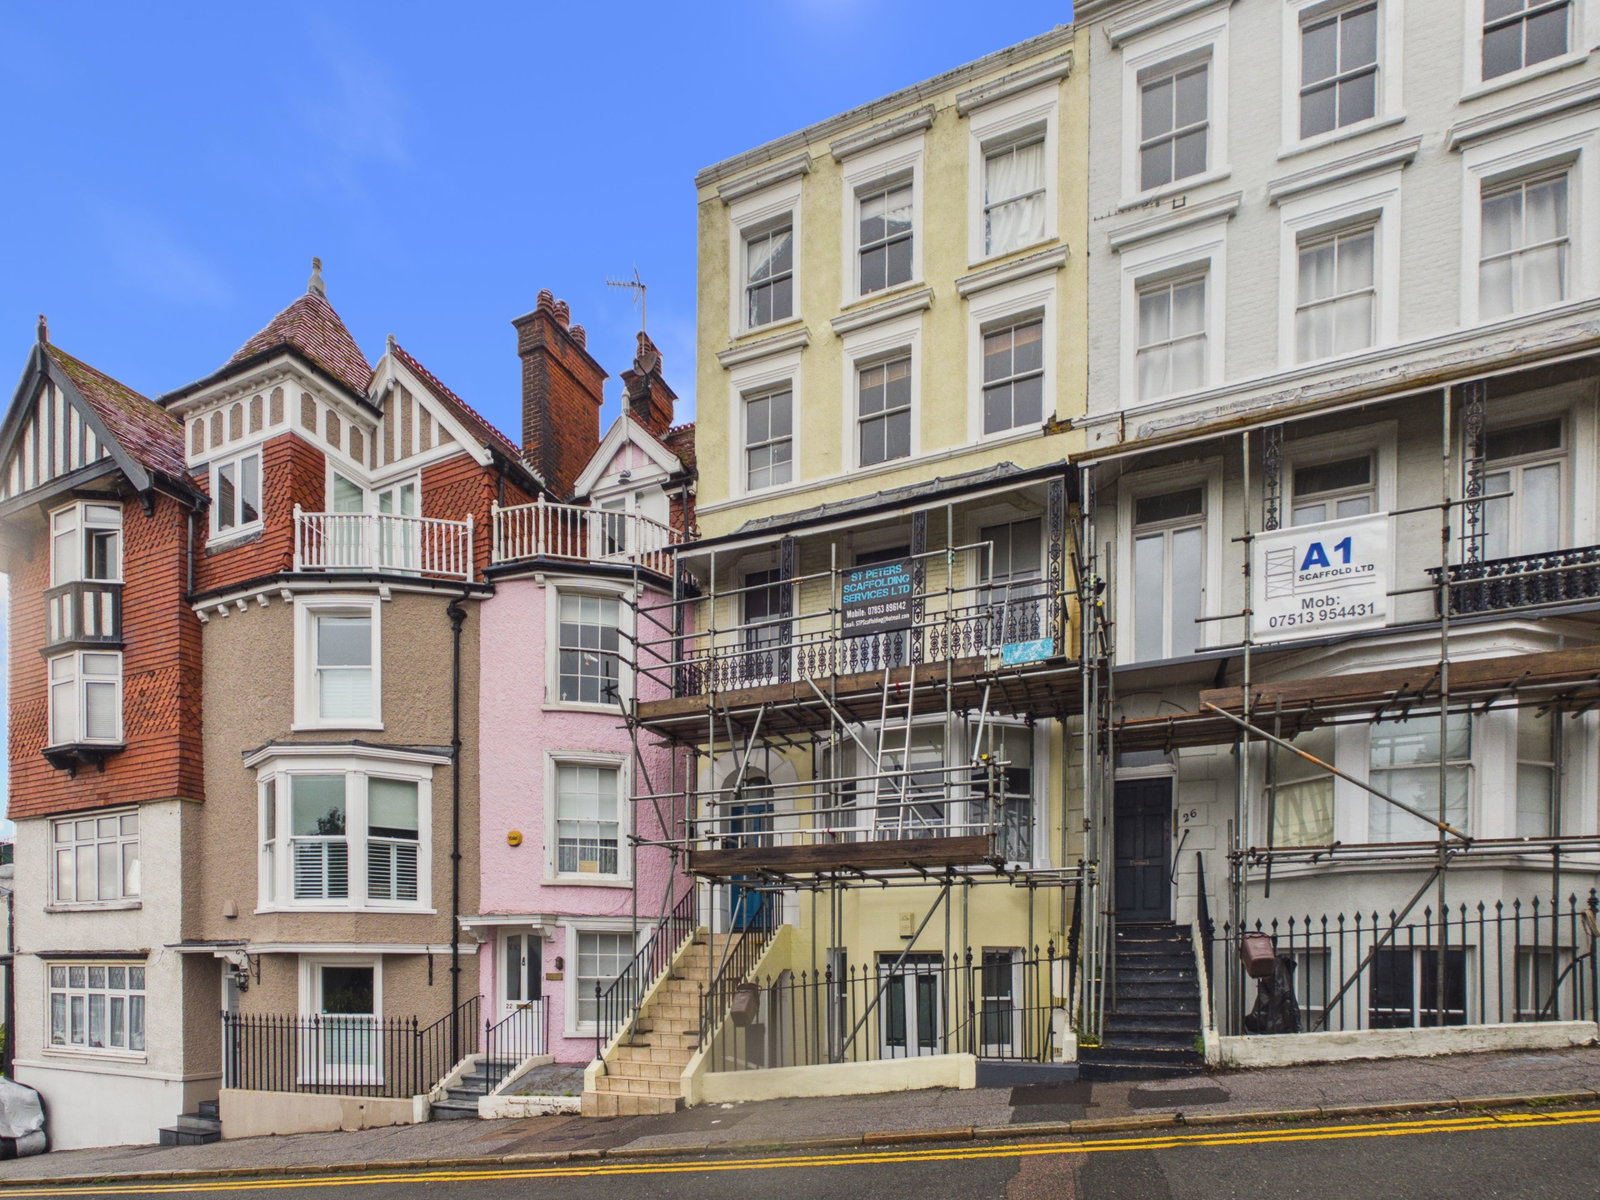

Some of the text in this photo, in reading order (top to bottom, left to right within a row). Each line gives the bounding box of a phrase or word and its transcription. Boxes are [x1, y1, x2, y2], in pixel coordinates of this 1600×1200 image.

[1300, 536, 1352, 571] A1
[850, 564, 902, 582] ST PETERS
[1298, 564, 1375, 582] SCAFFOLD LTD
[843, 574, 910, 593] SCAFFOLDING
[843, 584, 910, 604] SERVICES LTD
[1301, 595, 1341, 610] Mob:
[846, 601, 906, 619] Mobile: 07853 896142
[1269, 602, 1375, 628] 07513 954431
[1183, 809, 1197, 823] 26
